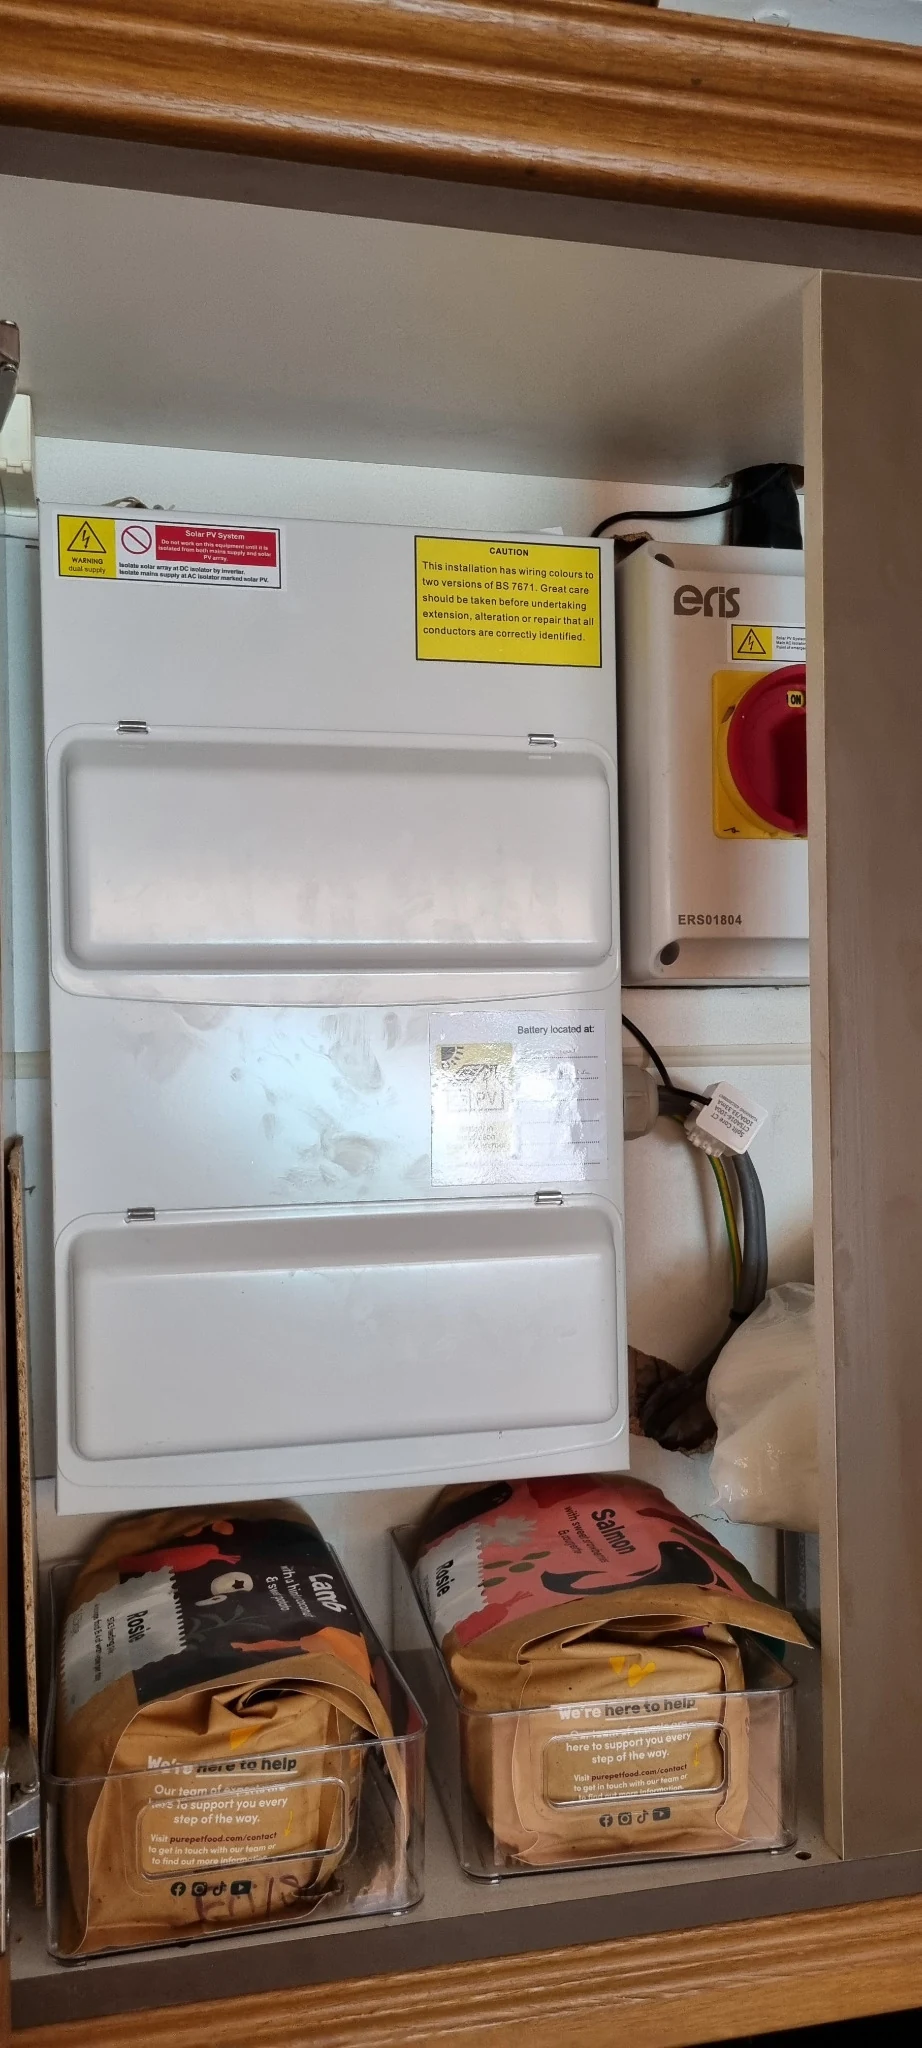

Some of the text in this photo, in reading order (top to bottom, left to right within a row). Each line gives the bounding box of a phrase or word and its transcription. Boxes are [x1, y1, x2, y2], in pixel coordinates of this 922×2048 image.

[218, 532, 245, 540] System
[215, 543, 244, 551] equipment
[489, 547, 529, 557] CAUTION
[422, 561, 594, 580] This installation has wiring colours to
[422, 578, 590, 595] two versions of BS 7671. Great care
[422, 594, 587, 612] should be taken before undertaking
[674, 584, 740, 618] eris
[422, 611, 472, 621] extension,
[474, 612, 520, 622] alteration
[533, 616, 561, 626] repair
[563, 616, 582, 626] that
[583, 617, 594, 626] all
[423, 627, 586, 641] conductors are correctly identified.
[790, 694, 802, 705] ON
[678, 914, 742, 925] ERS01804
[517, 1024, 595, 1035] Battery located at:
[711, 1112, 745, 1138] Split Core CT
[564, 1506, 580, 1522] with
[591, 1509, 636, 1554] Salmon
[436, 1559, 455, 1597] Rosie
[308, 1574, 347, 1612] Lamb
[127, 1610, 151, 1643] Rosie
[604, 1704, 640, 1717] here
[643, 1702, 660, 1713] to
[664, 1698, 696, 1711] help
[566, 1732, 692, 1752] here to support you every
[240, 1760, 257, 1770] to
[261, 1757, 296, 1771] help
[592, 1748, 670, 1765] step of the way.
[592, 1764, 687, 1782] purepetfood.com/contact
[155, 1784, 222, 1796] Our team of
[583, 1785, 596, 1793] get
[606, 1781, 627, 1789] touch
[190, 1799, 235, 1812] support
[236, 1800, 256, 1811] you
[258, 1797, 288, 1810] every
[174, 1812, 260, 1826] step of the way.
[150, 1832, 277, 1844] Visit purepetfood.com/contact
[159, 1846, 173, 1856] get
[175, 1846, 183, 1854] in
[184, 1846, 208, 1855] touch
[210, 1846, 228, 1854] with
[246, 1845, 266, 1853] team
[162, 1857, 179, 1865] find
